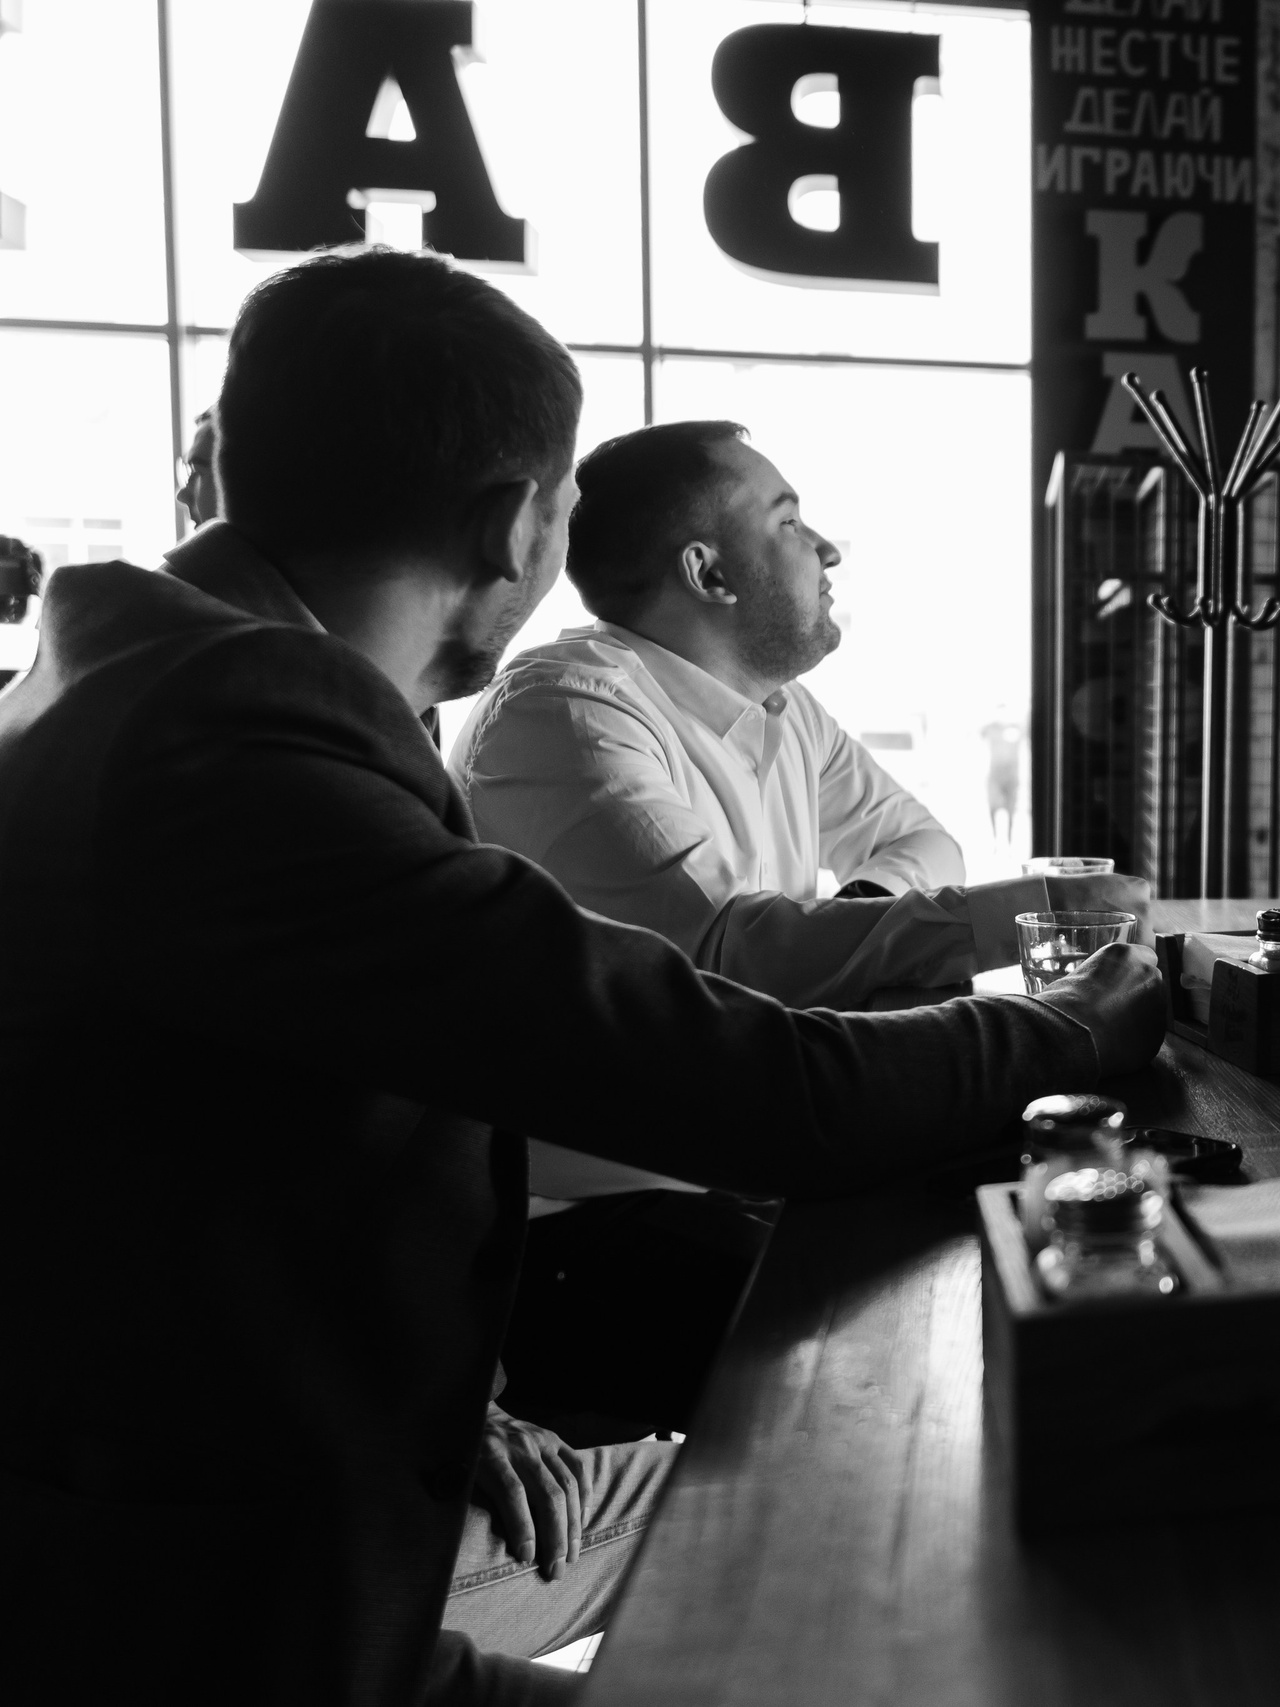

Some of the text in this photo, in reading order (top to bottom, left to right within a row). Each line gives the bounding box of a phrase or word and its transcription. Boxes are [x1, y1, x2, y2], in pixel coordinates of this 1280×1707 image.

[1050, 25, 1241, 84] ЖЕСТЧЕ
[1064, 86, 1222, 143] ДЕЛАЙ
[1036, 143, 1254, 203] ИГРАЮЧИ
